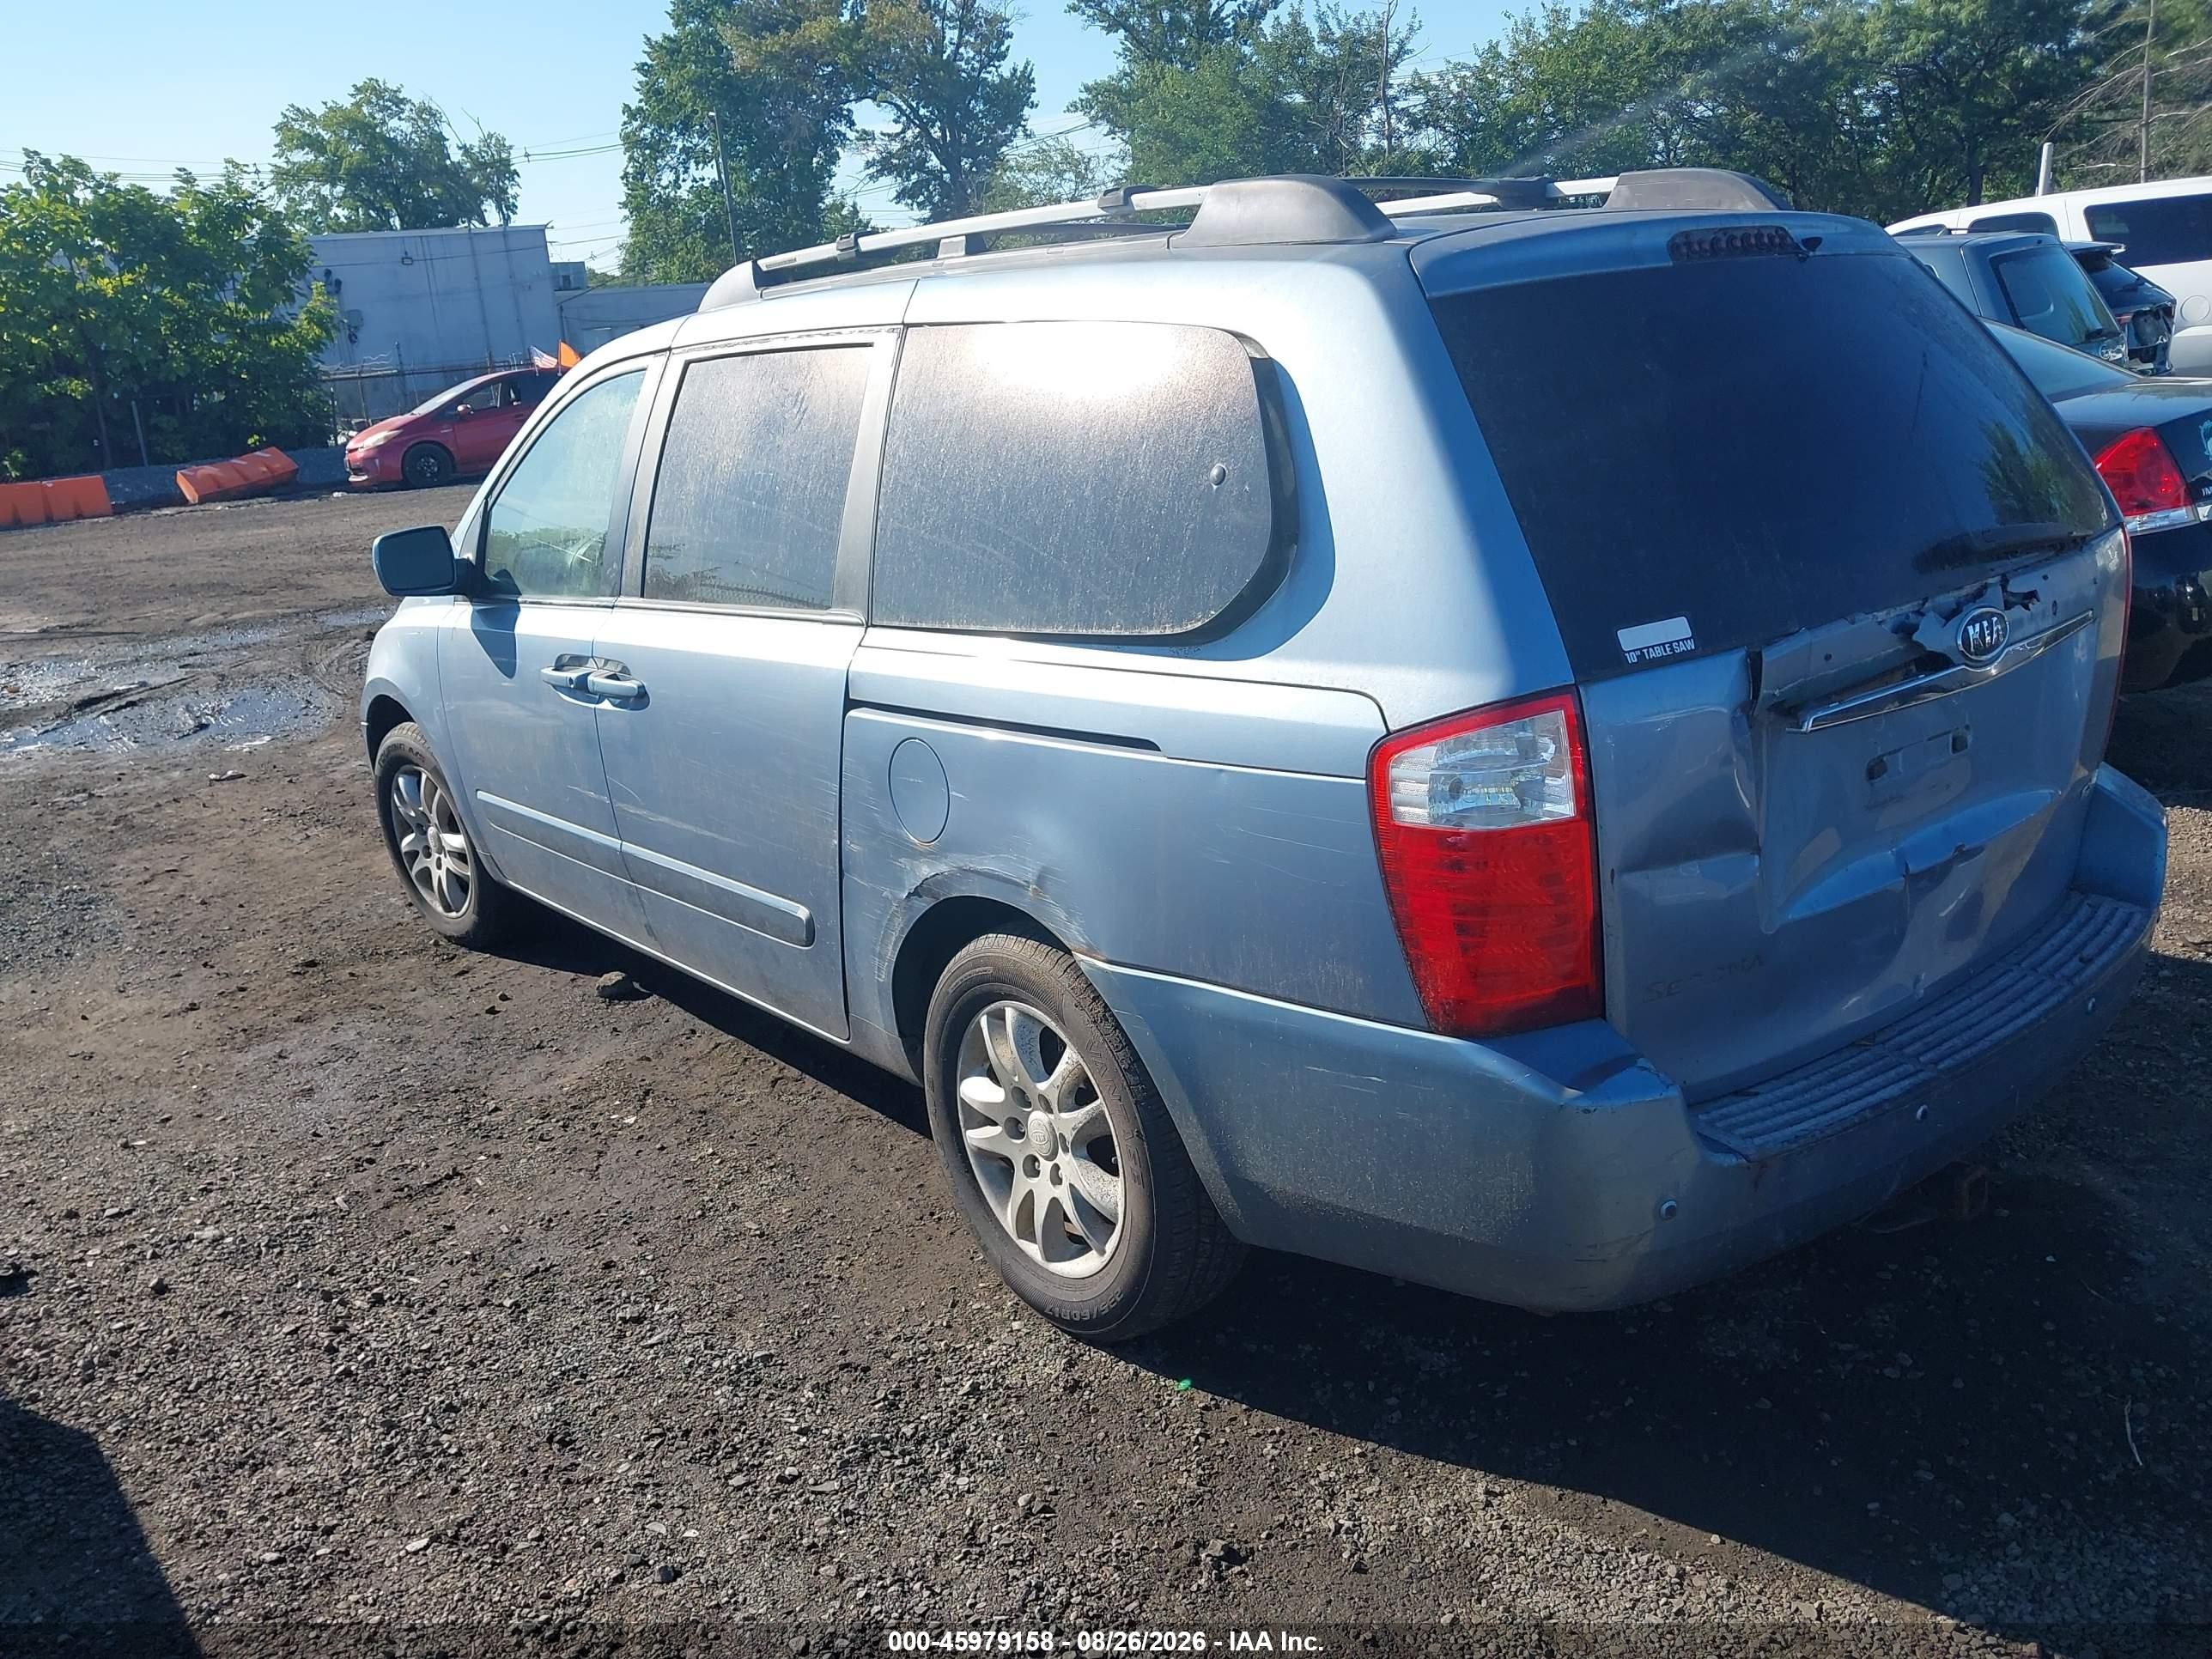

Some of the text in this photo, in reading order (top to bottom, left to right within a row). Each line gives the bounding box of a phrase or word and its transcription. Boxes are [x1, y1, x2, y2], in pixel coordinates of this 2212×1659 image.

[1966, 617, 2004, 652] KIA
[1624, 638, 1696, 664] 10" TABLE SAW
